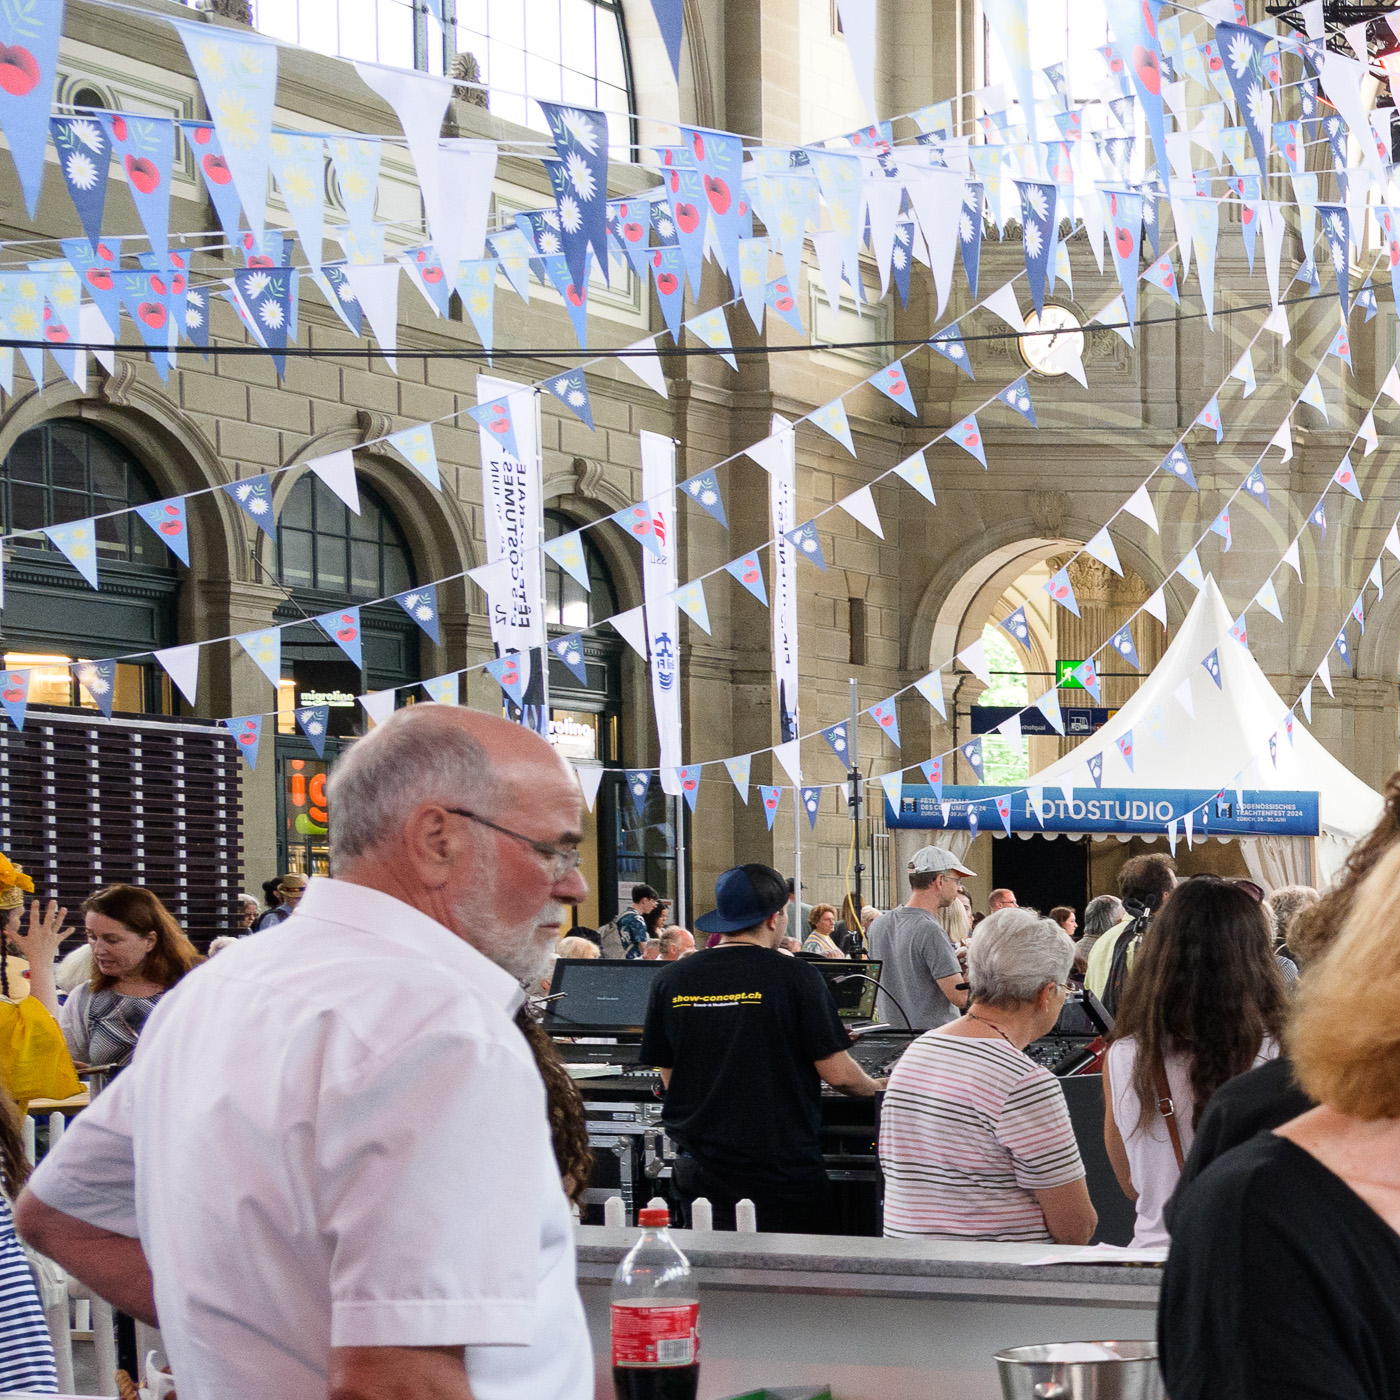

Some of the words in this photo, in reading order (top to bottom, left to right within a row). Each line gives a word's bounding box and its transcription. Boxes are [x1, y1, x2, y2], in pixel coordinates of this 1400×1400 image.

[300, 690, 355, 703] migrolino
[549, 718, 591, 736] rolino
[1021, 724, 1046, 732] nhofquai
[1025, 799, 1174, 821] FOTOSTUDIO
[672, 992, 763, 1004] show-concept.ch
